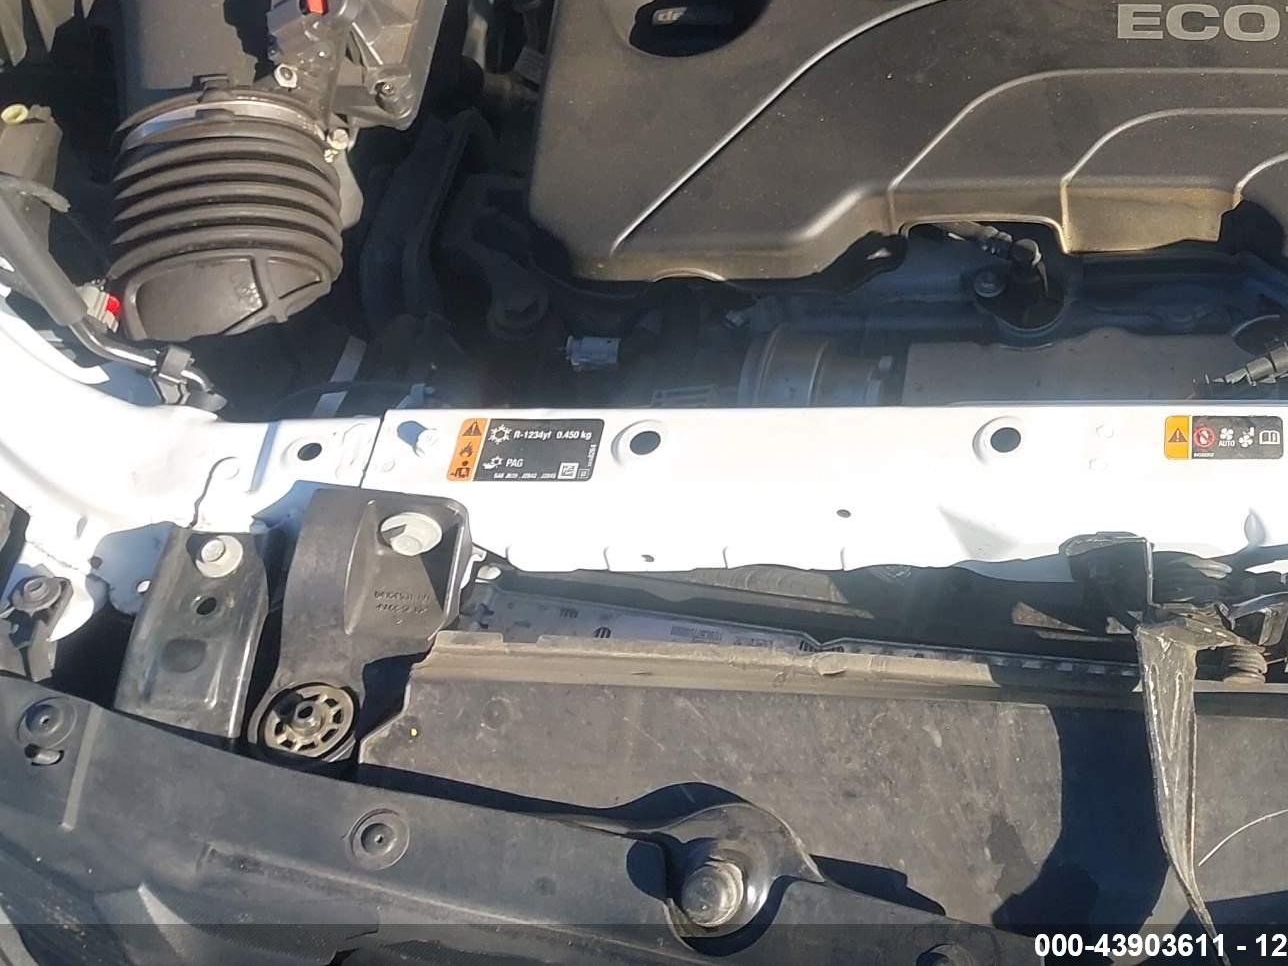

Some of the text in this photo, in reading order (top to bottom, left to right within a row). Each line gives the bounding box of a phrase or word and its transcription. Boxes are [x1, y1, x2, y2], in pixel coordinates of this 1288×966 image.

[556, 431, 579, 439] 0.450
[580, 430, 592, 441] kg
[1218, 439, 1235, 448] AUTO
[505, 459, 524, 467] PAG
